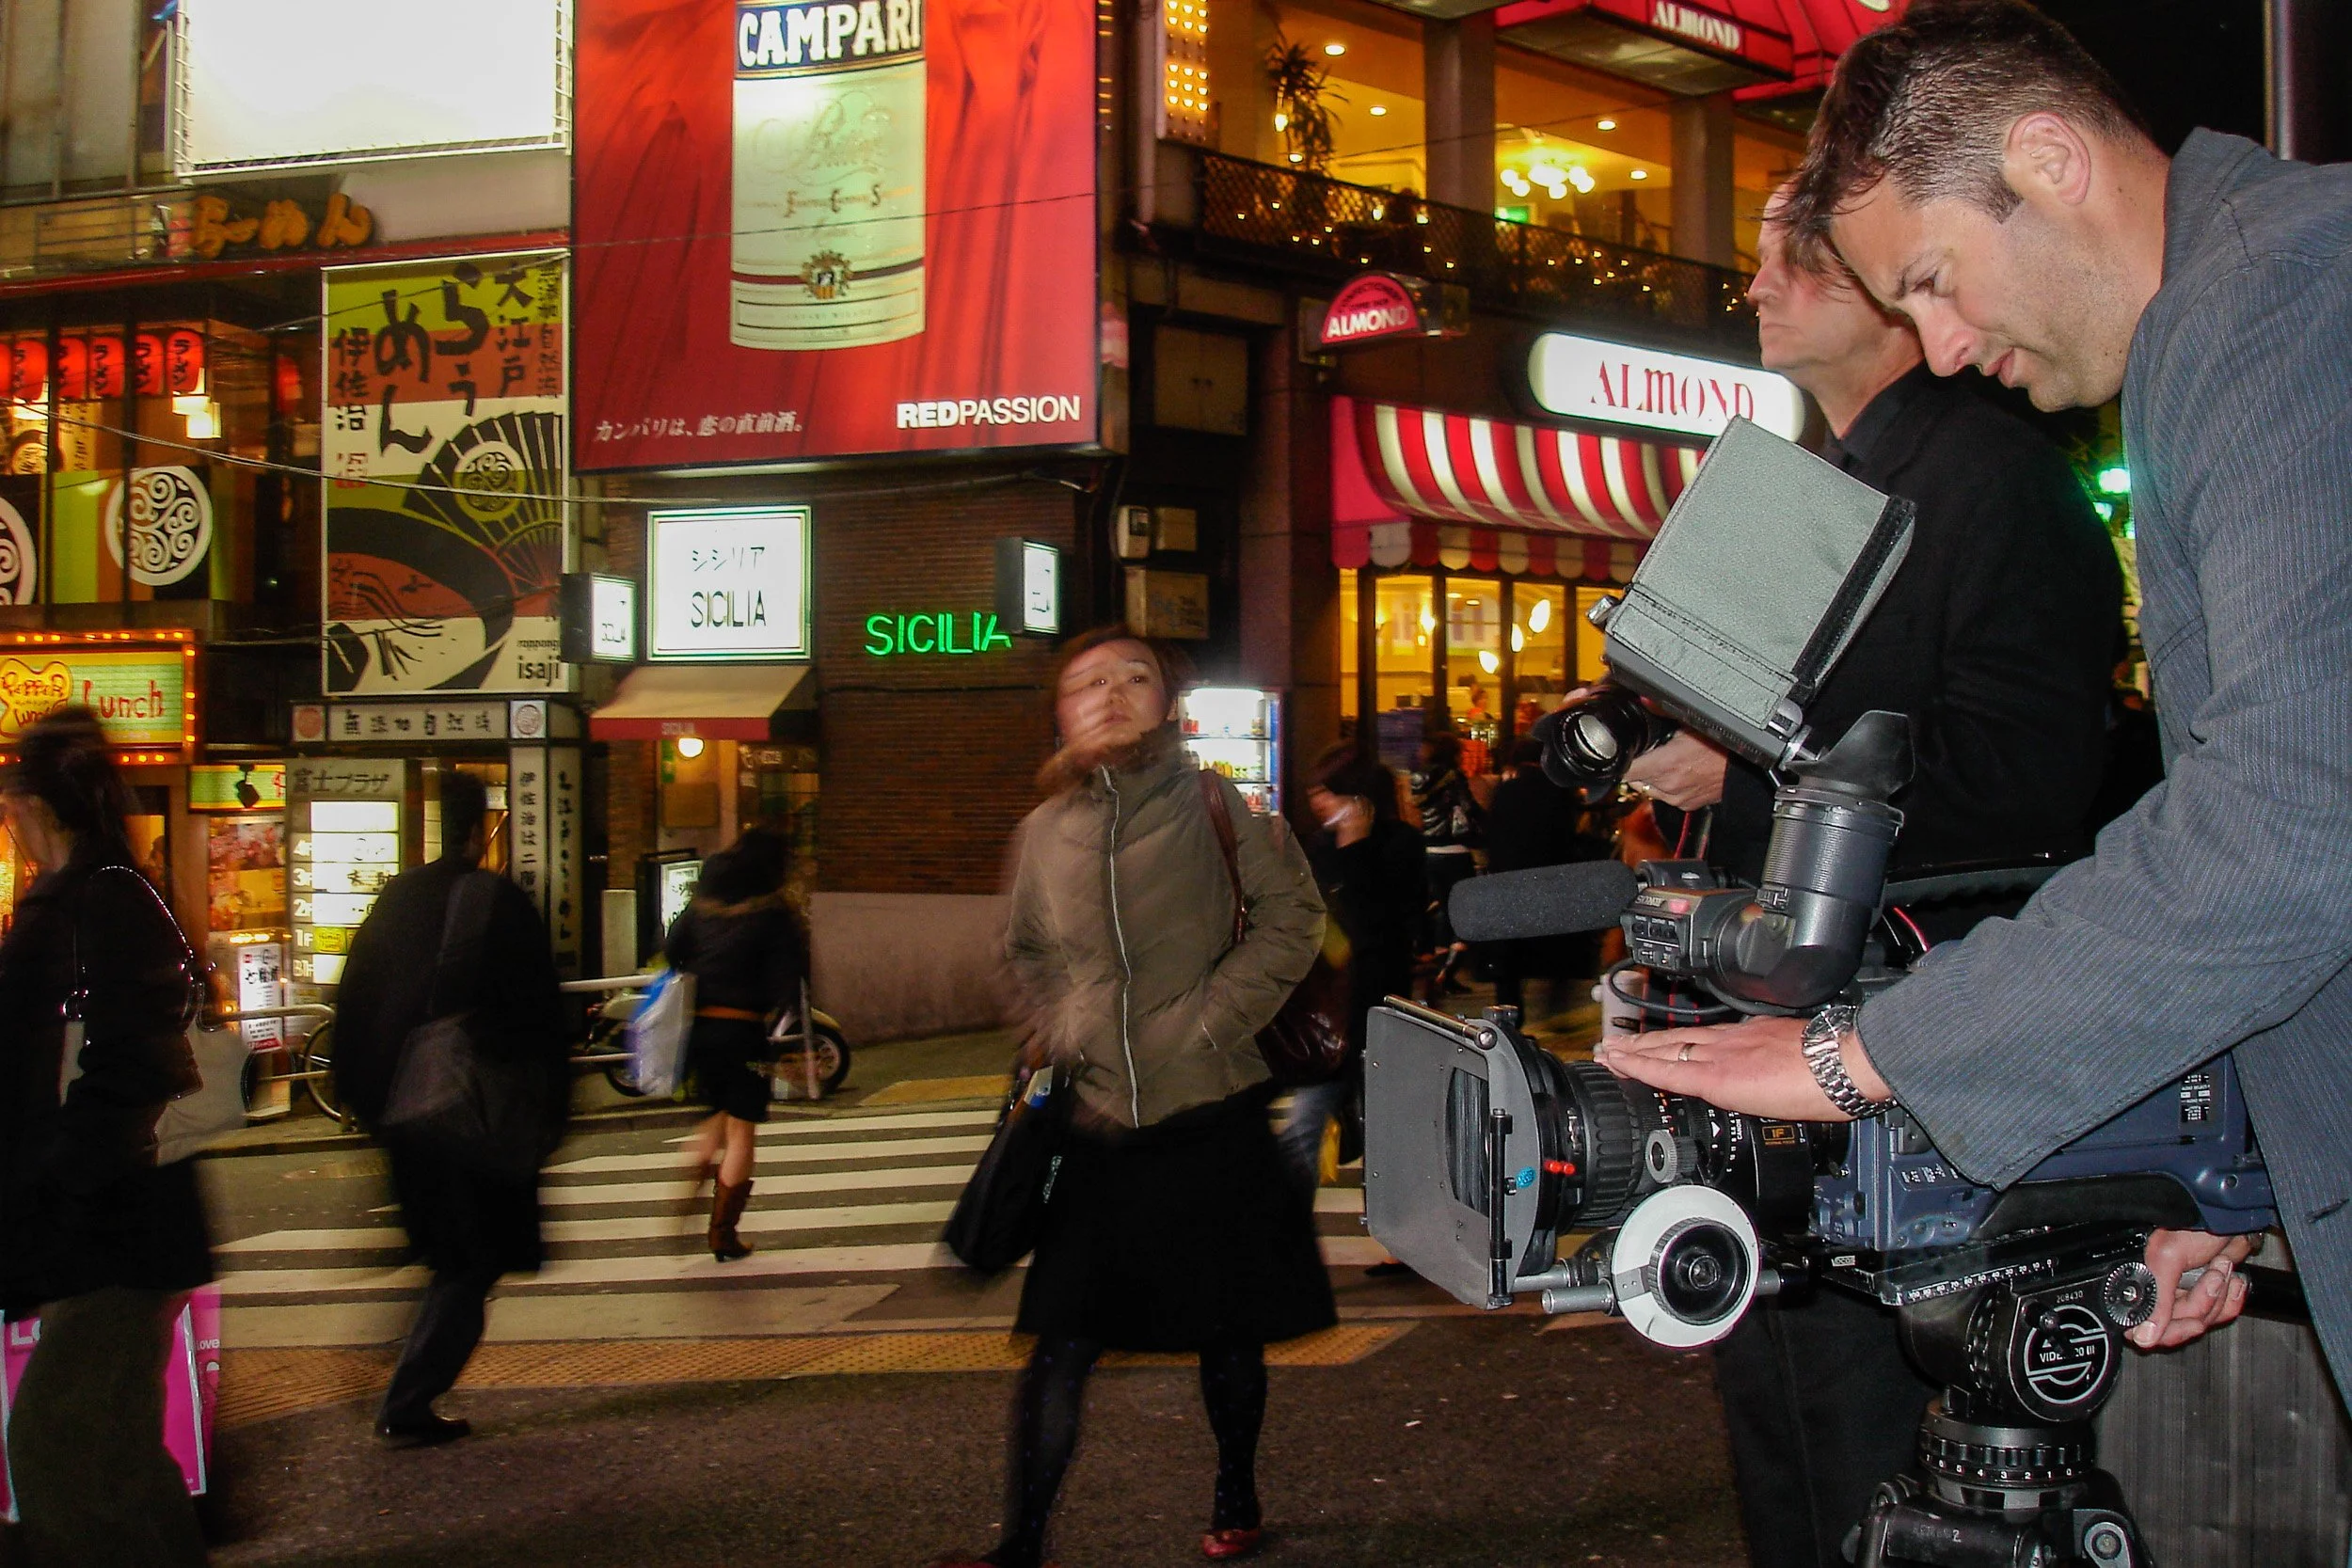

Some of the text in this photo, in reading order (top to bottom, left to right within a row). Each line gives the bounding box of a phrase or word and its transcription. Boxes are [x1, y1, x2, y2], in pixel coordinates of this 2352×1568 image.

[739, 0, 922, 67] CAMPARI
[1651, 0, 1740, 51] ALMOND
[191, 193, 373, 259] らーめん
[494, 263, 534, 398] 大江戸
[1326, 305, 1410, 338] ALMOND
[1591, 360, 1754, 422] ALMOND
[691, 546, 766, 572] シシリア
[691, 590, 767, 628] SICILIA
[866, 612, 1013, 657] SICILIA
[518, 655, 562, 687] isaji
[82, 679, 166, 720] Lunch
[294, 928, 313, 947] 1F
[2039, 1351, 2064, 1363] VIDE
[1977, 1468, 1984, 1477] 4
[2000, 1470, 2008, 1480] 3
[2024, 1471, 2032, 1480] 2
[2046, 1470, 2052, 1479] 1
[1952, 1528, 1962, 1543] 2
